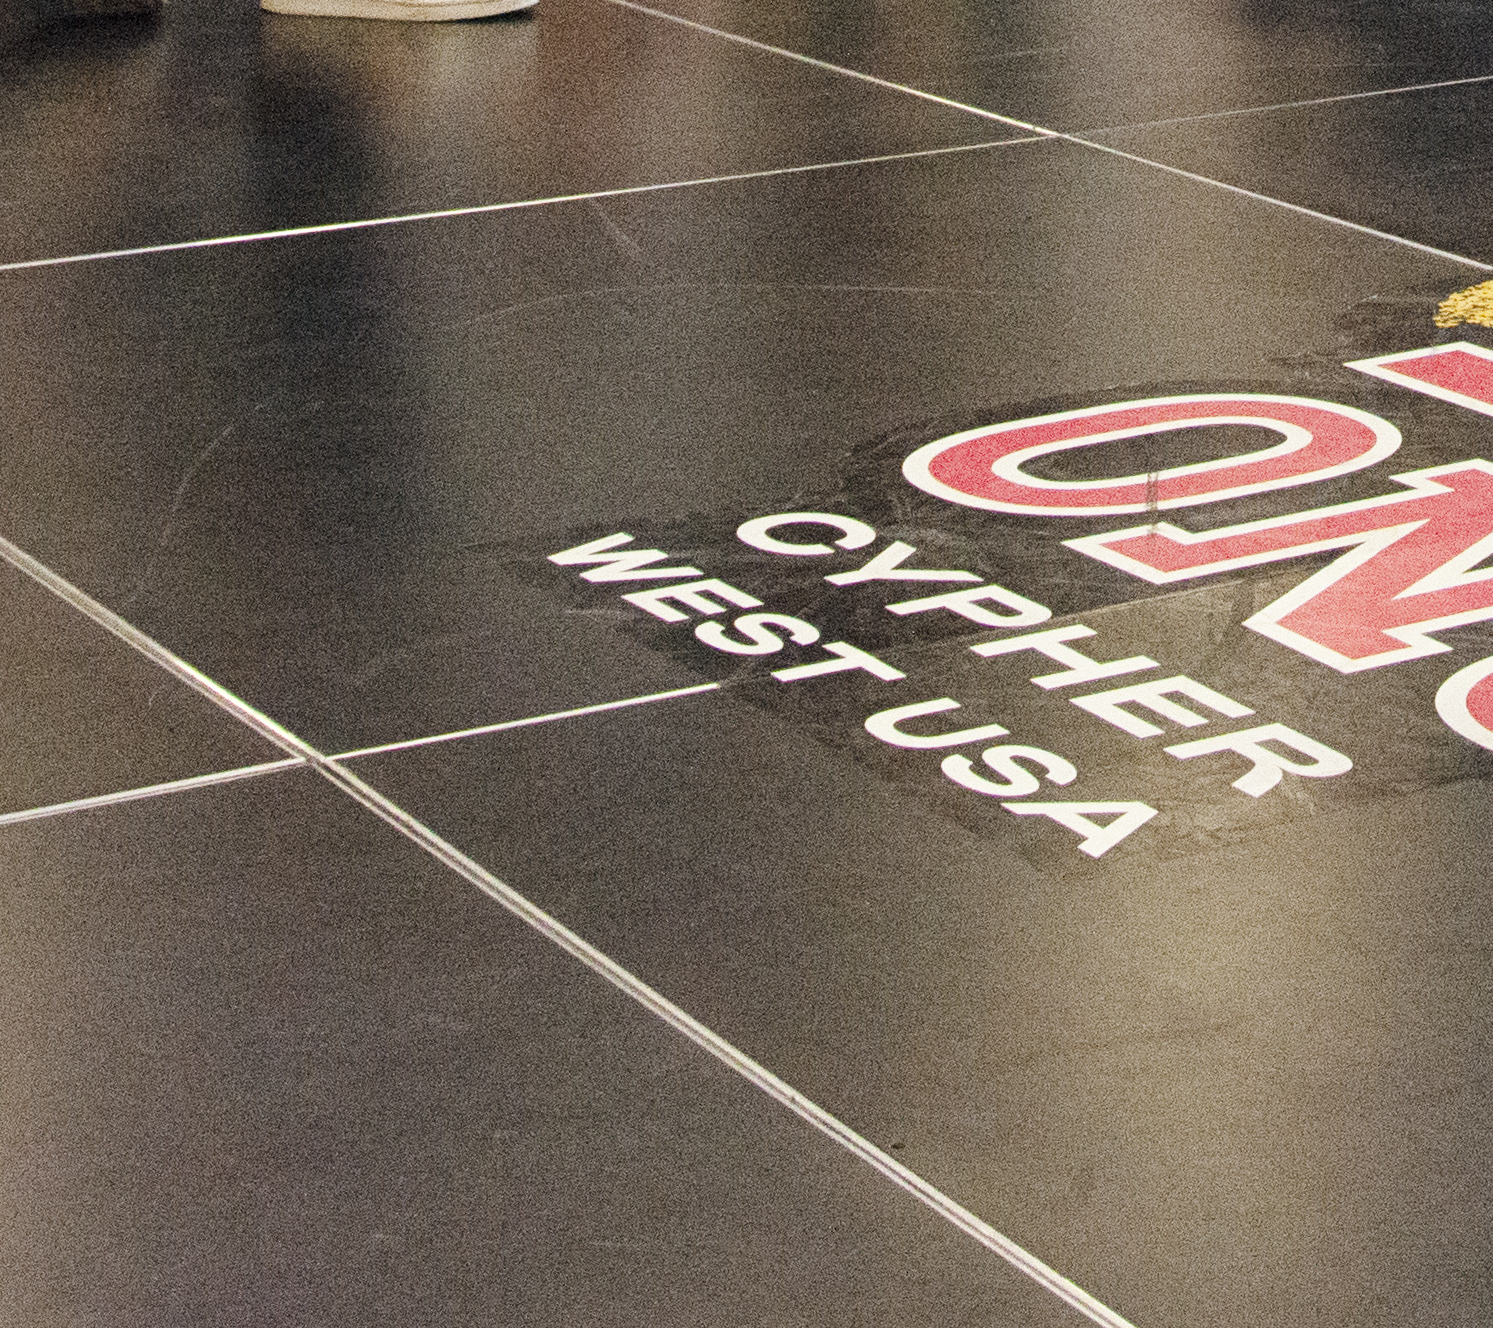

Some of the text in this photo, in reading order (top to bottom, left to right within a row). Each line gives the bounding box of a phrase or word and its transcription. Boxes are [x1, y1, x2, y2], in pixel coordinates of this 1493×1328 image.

[547, 531, 1159, 860] WEST USA
[736, 511, 1354, 798] CYPHER
